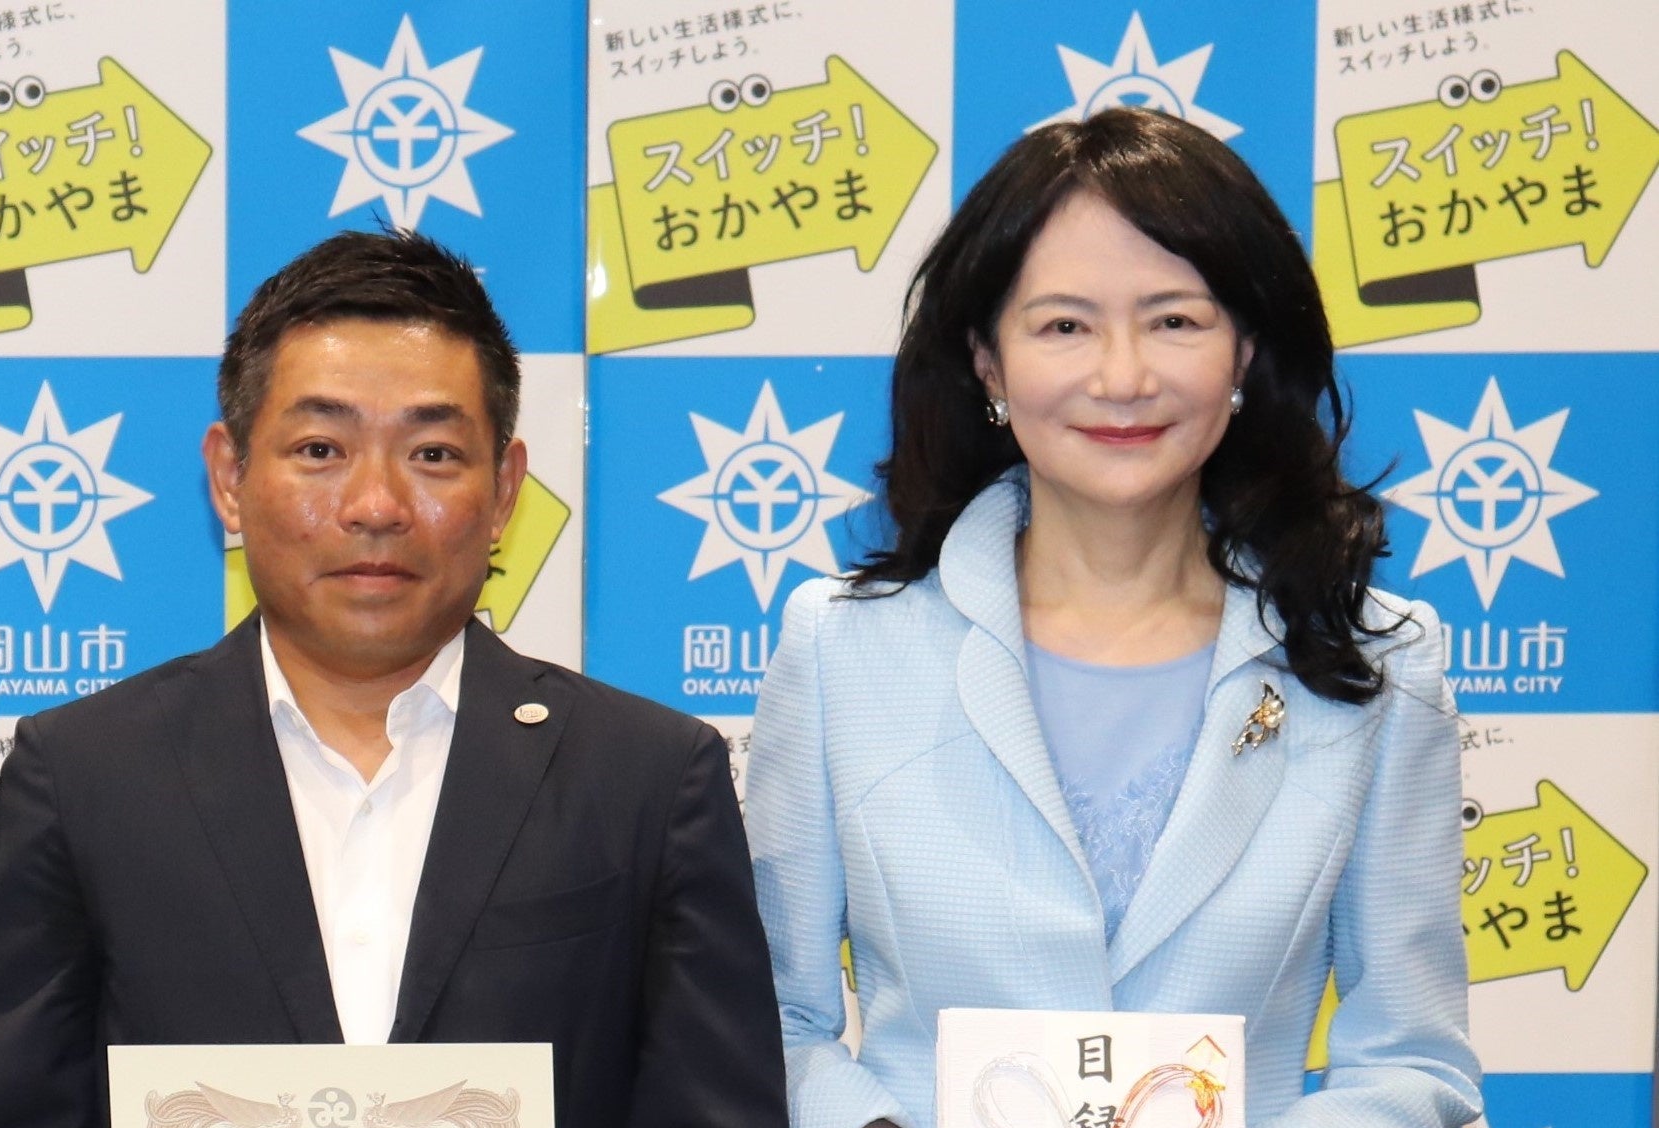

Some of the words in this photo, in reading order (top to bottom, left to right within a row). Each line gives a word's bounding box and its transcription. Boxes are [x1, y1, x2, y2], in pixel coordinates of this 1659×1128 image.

[604, 1, 804, 52] 新しい生活様式に、
[643, 104, 869, 191] スイッチ!
[1371, 98, 1599, 188] スイッチ!
[653, 169, 872, 251] おかやま
[1380, 165, 1601, 247] おかやま
[1442, 620, 1568, 671] 山市
[1448, 677, 1507, 694] YAMA
[1513, 676, 1563, 694] CITY
[1463, 891, 1582, 950] やま
